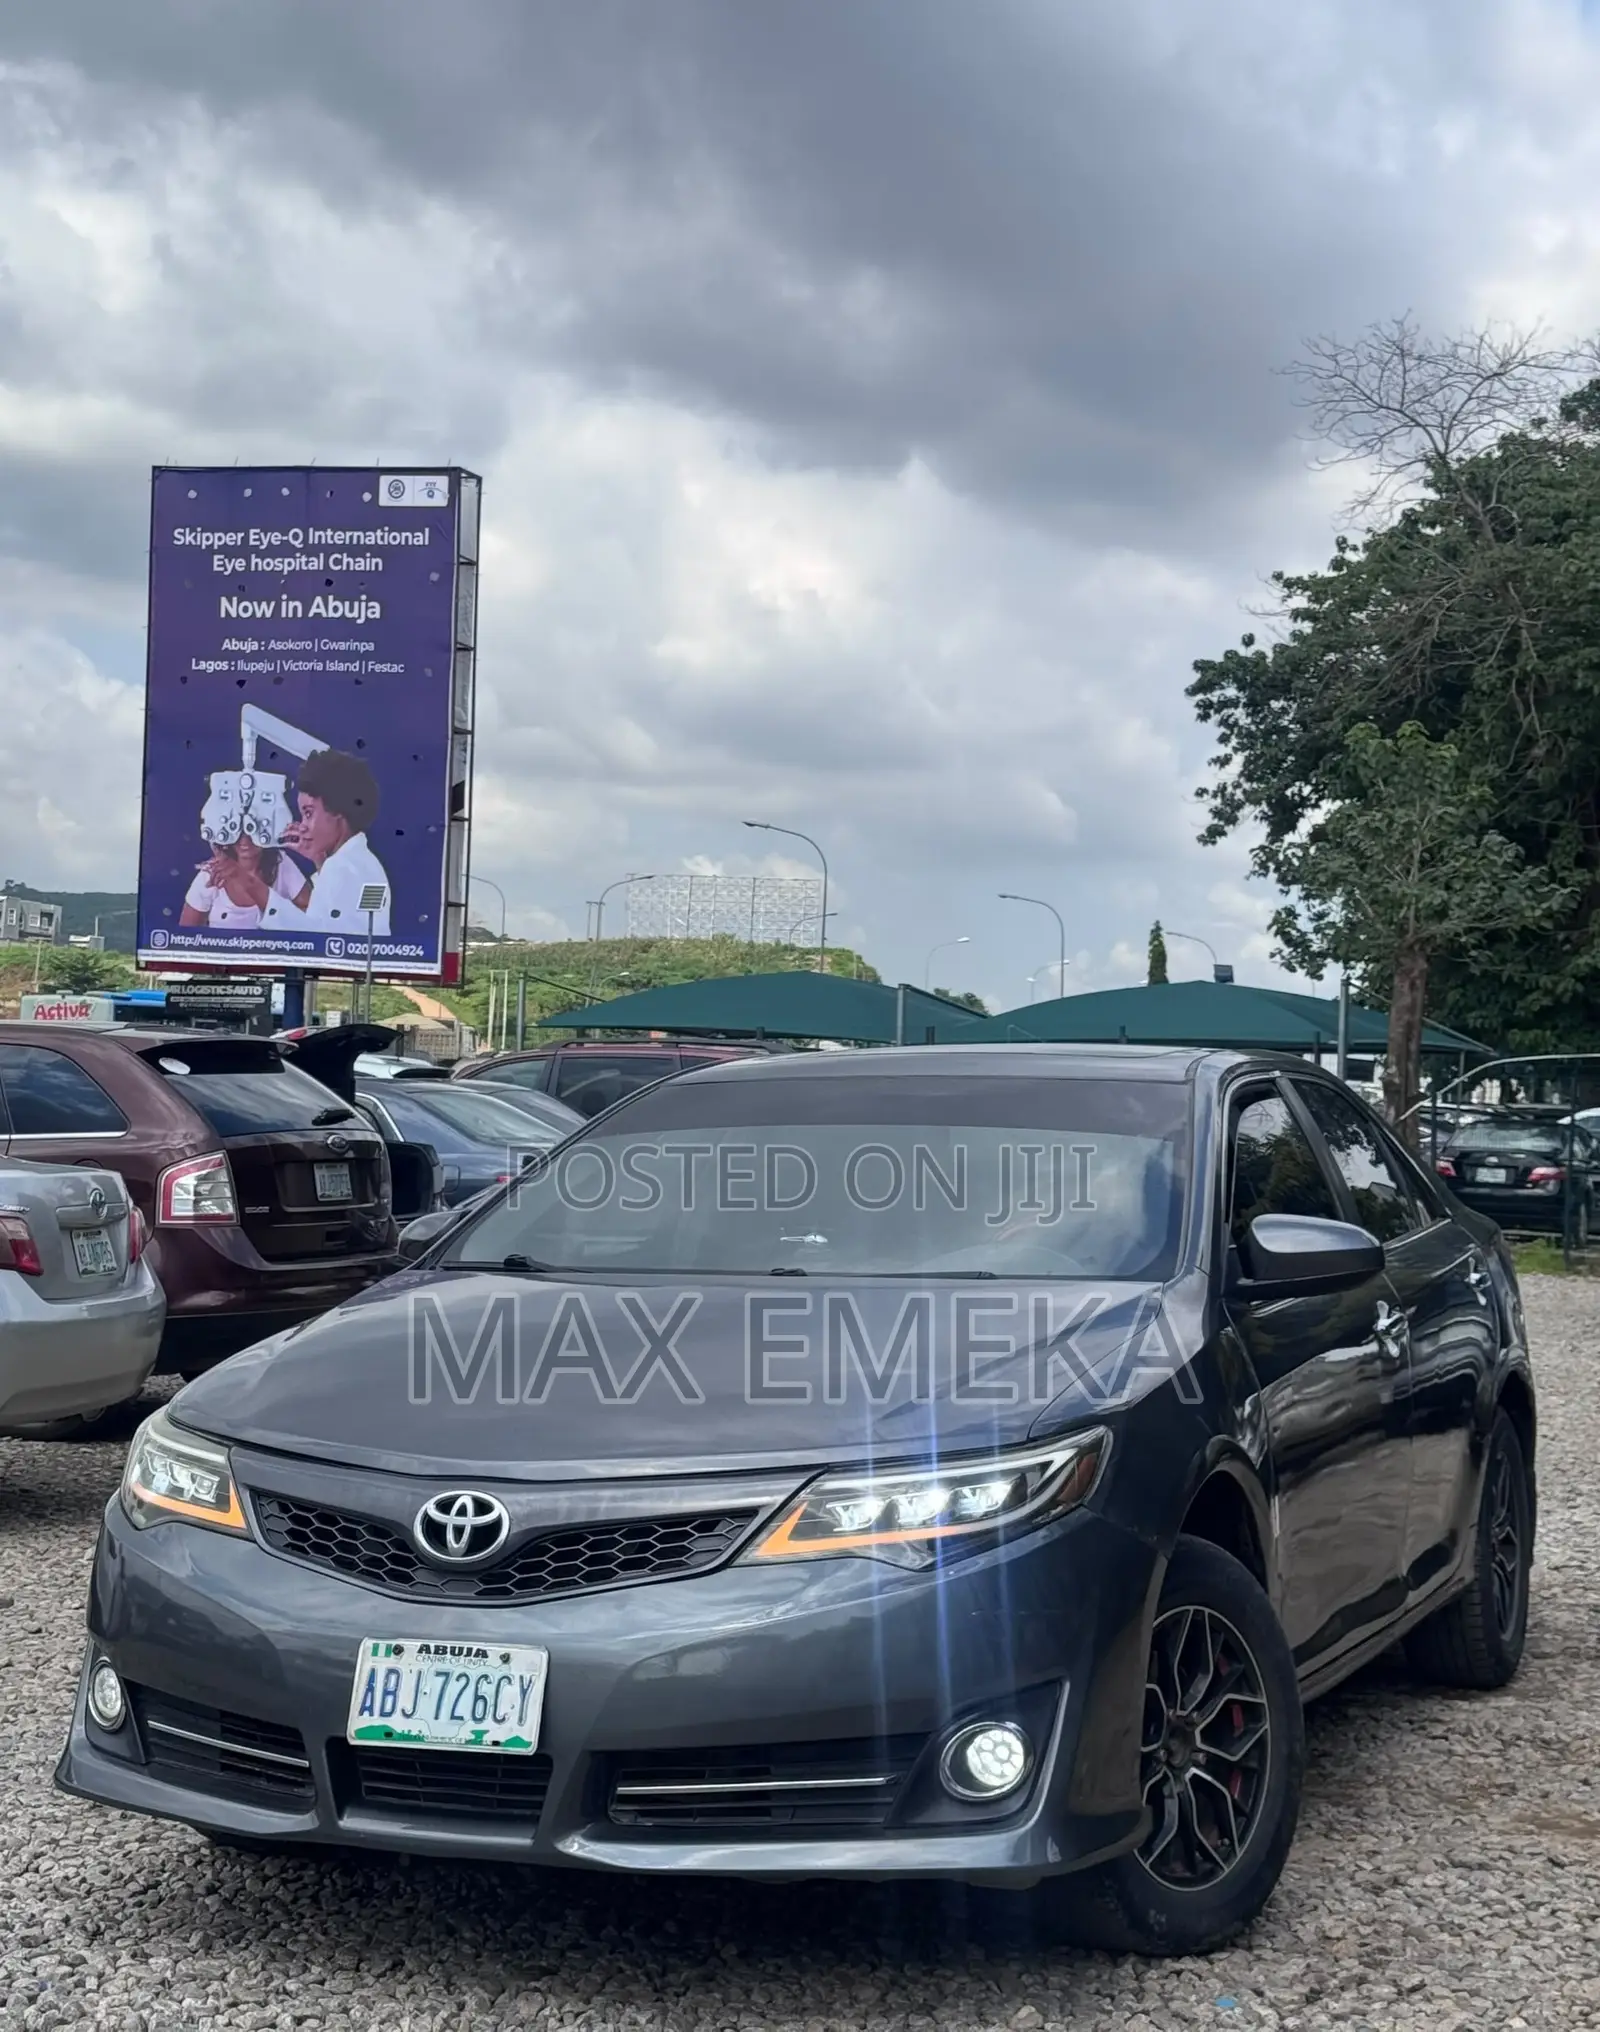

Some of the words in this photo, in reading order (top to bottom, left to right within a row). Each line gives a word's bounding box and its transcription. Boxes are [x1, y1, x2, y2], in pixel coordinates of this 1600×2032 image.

[173, 527, 244, 549] Skipper
[249, 528, 303, 549] Eye-Q
[308, 527, 429, 546] International
[213, 555, 246, 575] Eye
[250, 553, 324, 575] hospital
[328, 553, 383, 571] Chain
[219, 596, 275, 618] Now
[281, 595, 302, 618] in
[309, 595, 381, 623] Abuja
[268, 639, 311, 651] Asokoro
[320, 639, 374, 653] Gwarinpa
[237, 659, 274, 673] Ilupeju
[282, 659, 323, 671] Victoria
[325, 660, 359, 672] Island
[368, 661, 405, 673] Festac
[170, 933, 314, 951] http://www.skippereyeq.com
[347, 942, 425, 957] 0207004924
[34, 1001, 93, 1020] Activa
[416, 1643, 489, 1659] ABUJA
